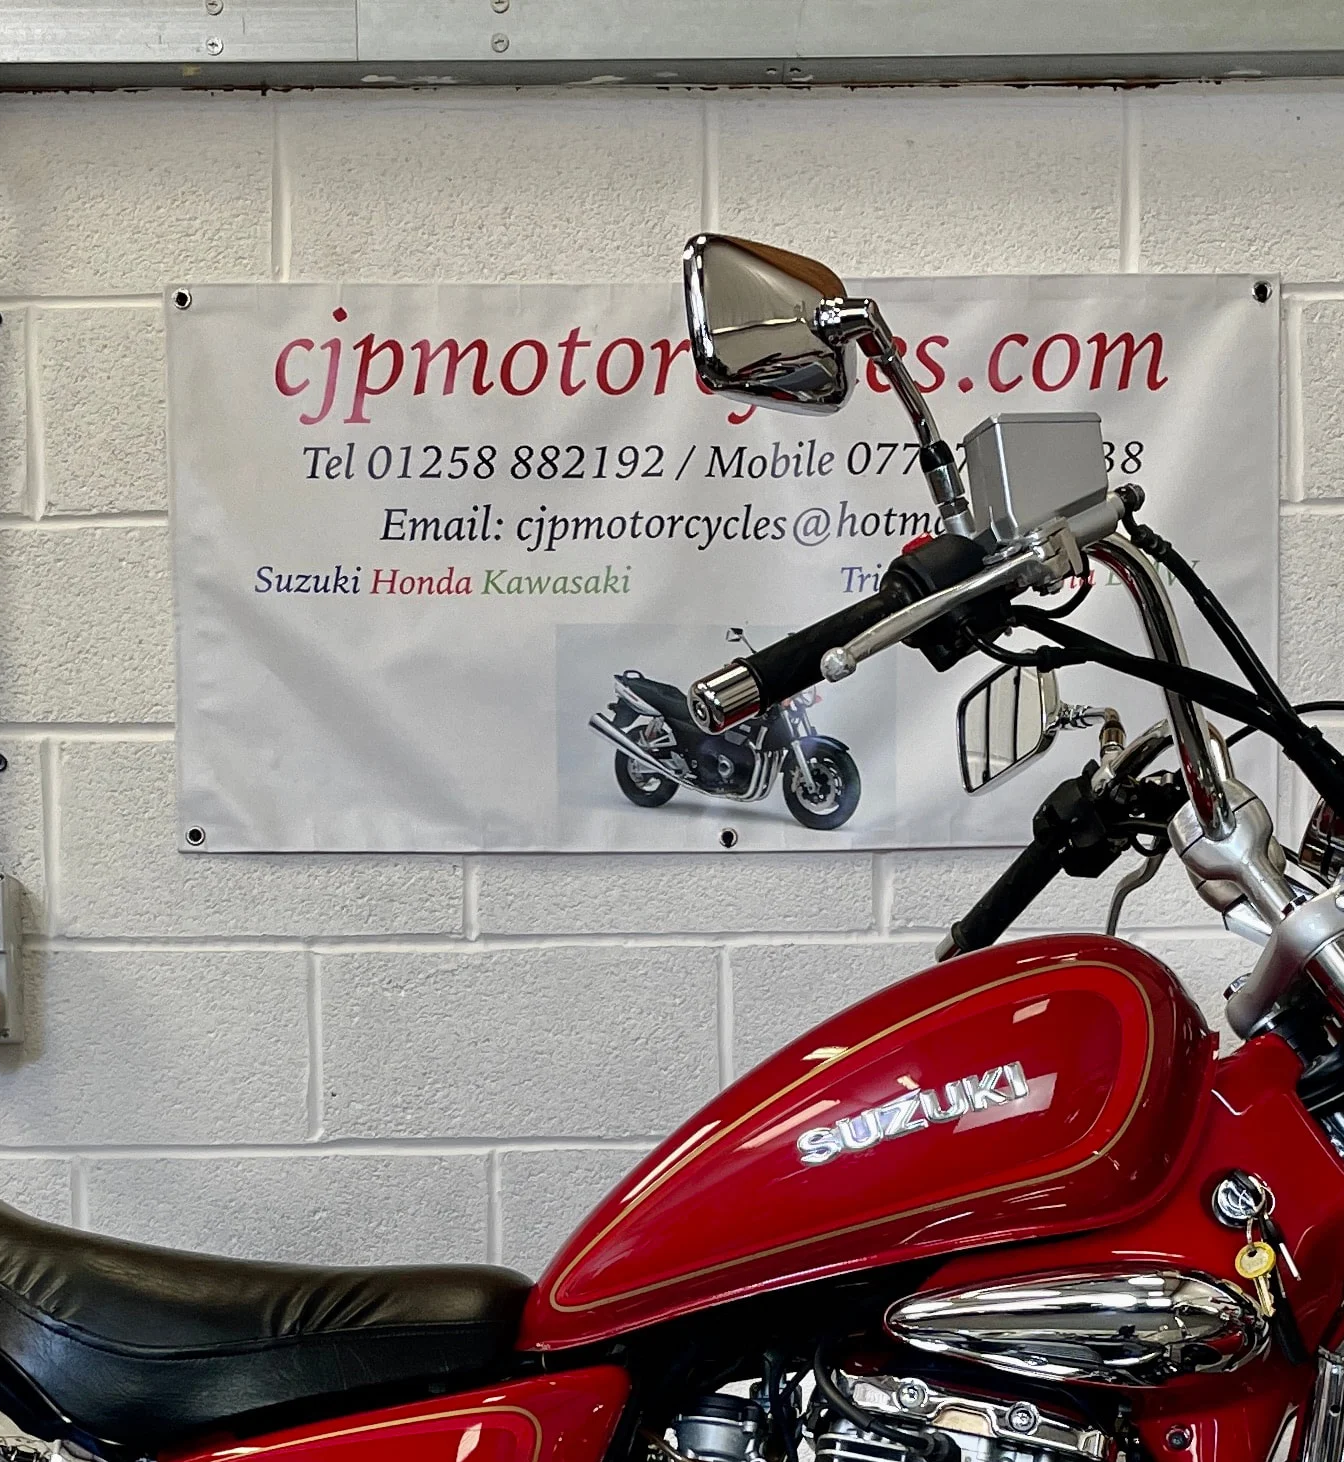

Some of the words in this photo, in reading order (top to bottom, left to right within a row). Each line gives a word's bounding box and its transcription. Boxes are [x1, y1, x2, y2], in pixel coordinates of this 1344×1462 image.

[274, 306, 1169, 425] cjpmotors.com
[302, 443, 355, 480] Tel
[367, 444, 498, 480] 01258
[510, 443, 665, 481] 882192
[705, 439, 835, 479] Mobile
[379, 504, 503, 542] Email:
[254, 565, 362, 595] Suzuki
[369, 566, 473, 596] Honda
[480, 564, 633, 596] Kawasaki
[796, 1061, 1031, 1165] SUZUKI
